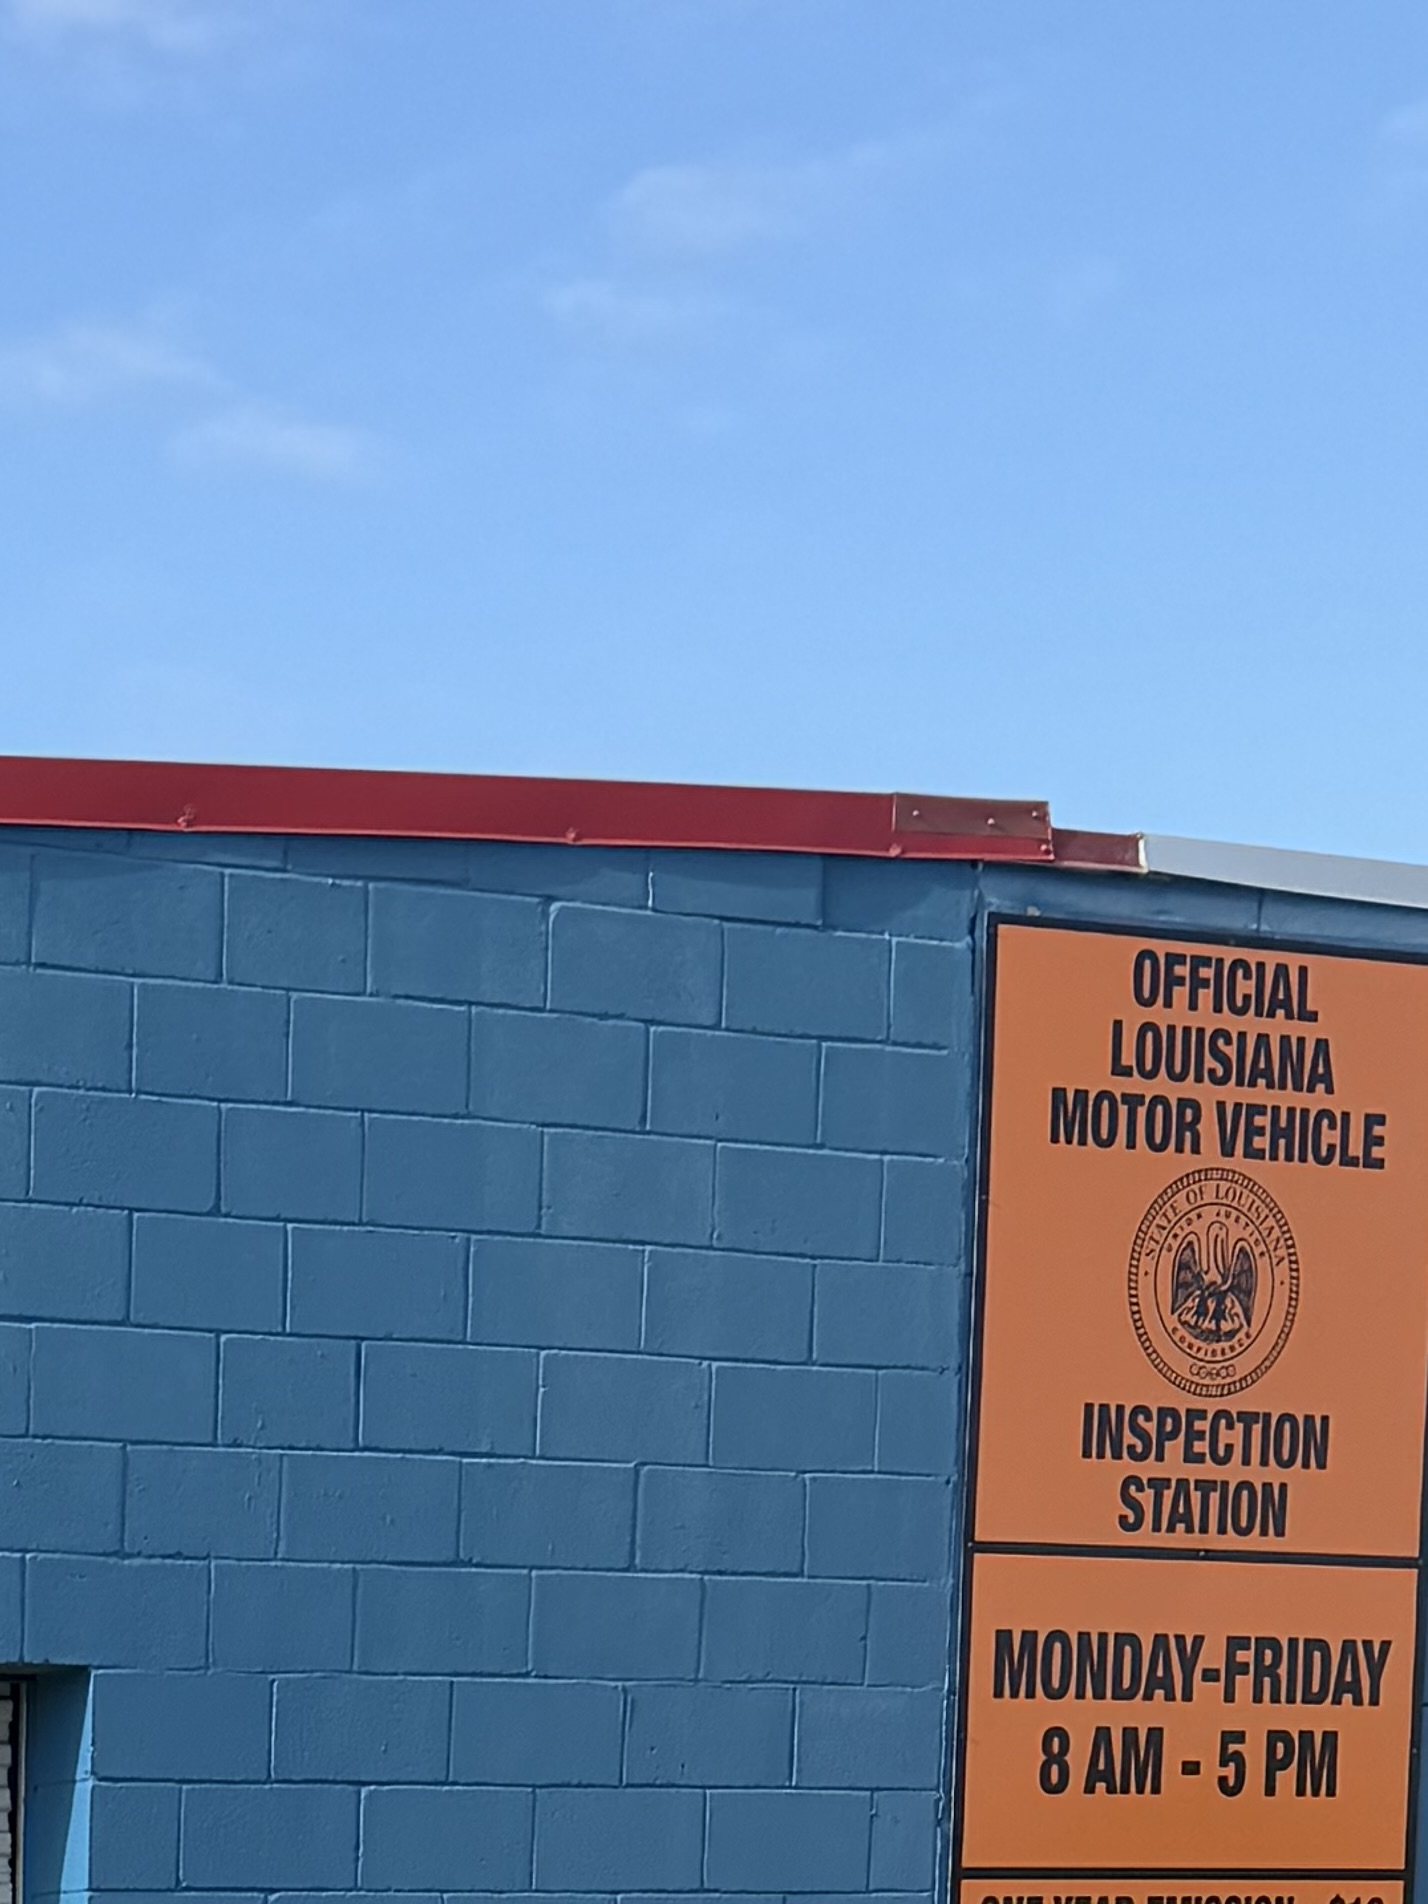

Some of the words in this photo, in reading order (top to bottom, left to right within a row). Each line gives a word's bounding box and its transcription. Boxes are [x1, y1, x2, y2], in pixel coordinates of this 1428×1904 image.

[1133, 949, 1318, 1022] OFFICIAL
[1111, 1020, 1334, 1094] LOUISIANA
[1050, 1087, 1201, 1155] MOTOR
[1216, 1101, 1386, 1169] VEHICLE
[1145, 1200, 1182, 1260] STATE
[1186, 1185, 1206, 1205] OF
[1215, 1183, 1286, 1267] LOUISIANA
[1082, 1403, 1329, 1470] INSPECTION
[1119, 1475, 1287, 1537] STATION
[993, 1629, 1392, 1706] MONDAY-FRIDAY
[1040, 1727, 1070, 1794] 8
[1084, 1726, 1163, 1795] AM
[1181, 1761, 1200, 1775] -
[1218, 1731, 1246, 1797] 5
[1265, 1730, 1338, 1797] PM
